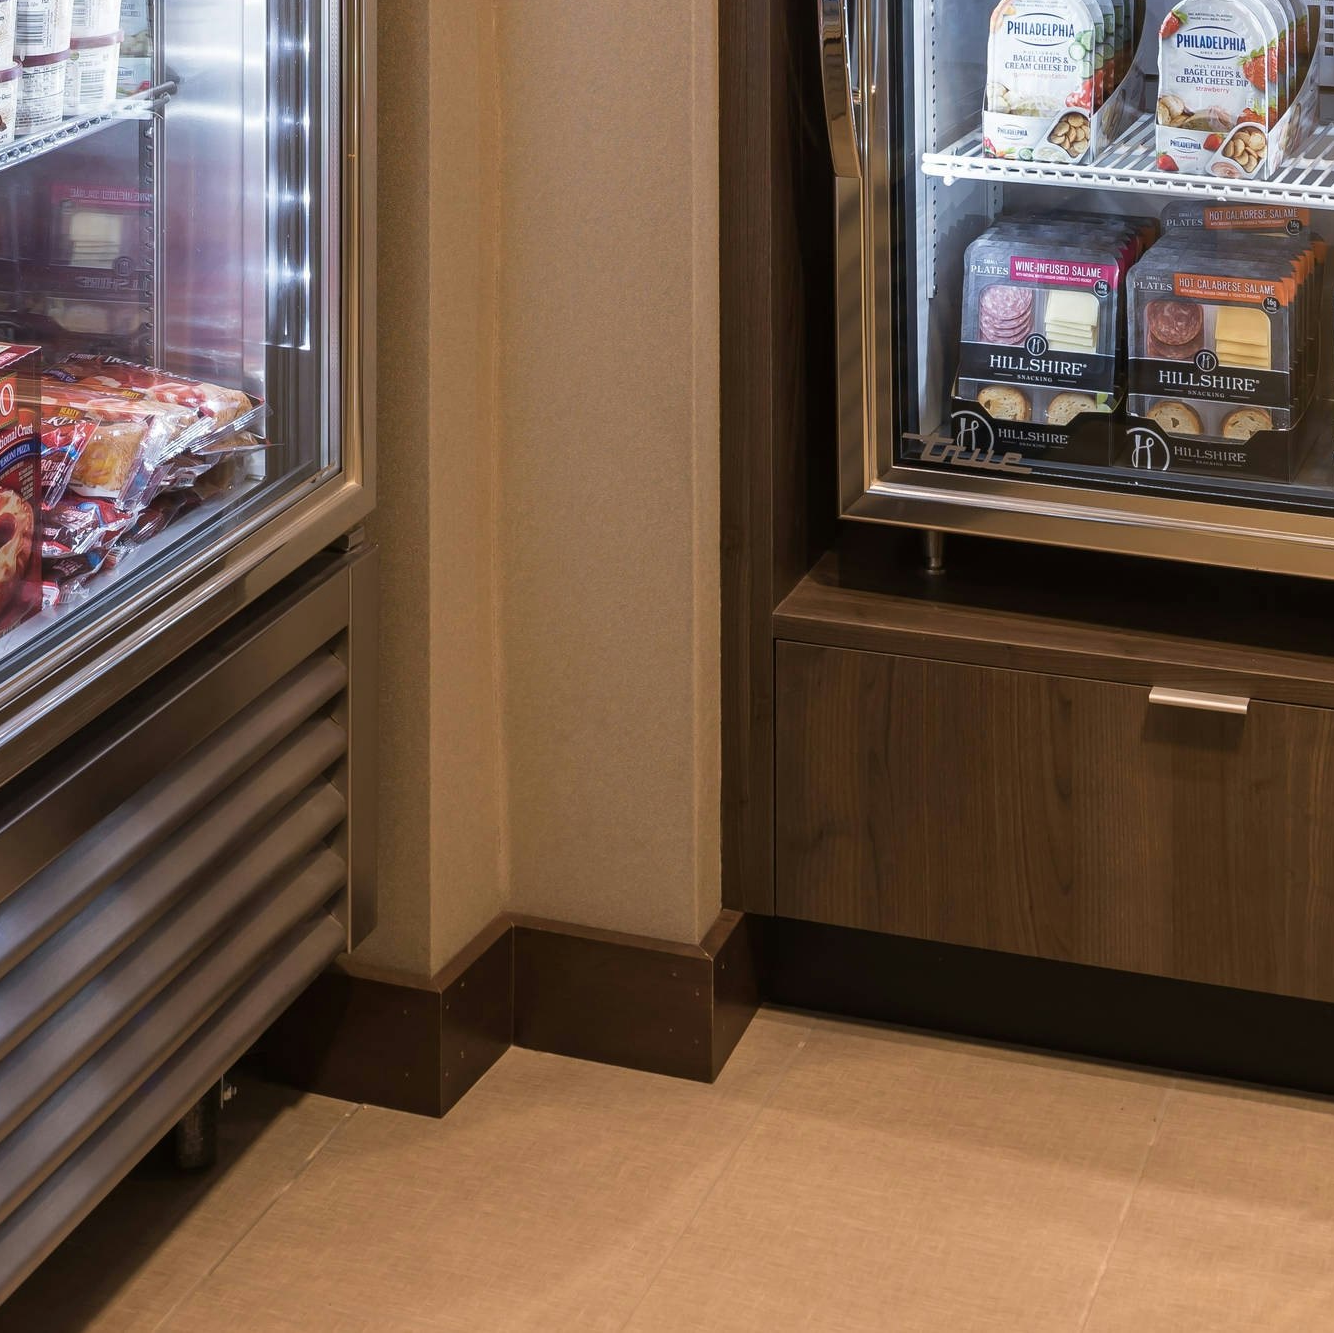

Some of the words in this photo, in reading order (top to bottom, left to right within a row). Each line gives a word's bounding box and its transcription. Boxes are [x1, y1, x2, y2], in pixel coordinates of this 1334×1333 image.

[1007, 20, 1076, 39] PHILADELPHIA
[1176, 33, 1247, 53] PHILADELPHIA
[1012, 54, 1035, 65] BAGEL
[1037, 55, 1061, 65] CHIPS
[1005, 62, 1031, 71] CREAM
[1033, 63, 1061, 72] CHEESE
[1062, 64, 1077, 74] DIP
[1183, 68, 1207, 77] BAGEL
[1209, 69, 1232, 78] CHIPS
[1175, 76, 1202, 85] CREAM
[1204, 77, 1233, 86] CHEESE
[1235, 78, 1249, 87] DIP
[1195, 86, 1229, 94] strawberry
[997, 126, 1028, 137] PHILADELPHIA
[1209, 210, 1224, 220] HOT
[1226, 209, 1267, 220] CALABRESE
[1269, 208, 1298, 218] SALAME
[1167, 217, 1203, 227] PLATES
[971, 265, 1009, 276] PLATES
[1015, 261, 1068, 276] WINE-INFUSED
[1072, 266, 1102, 278] SALAME
[1098, 281, 1108, 291] 16g
[1133, 282, 1173, 291] PLATES
[1179, 278, 1194, 289] HOT
[1197, 279, 1242, 292] CALABRESE
[1244, 284, 1275, 296] SALAME
[989, 354, 1082, 378] HILLSHIRE
[1017, 374, 1054, 383] SNACKING
[1159, 370, 1256, 393] HILLSHIRE
[1188, 390, 1224, 399] SNACKING
[17, 423, 34, 437] Crust
[998, 428, 1068, 445] HILLSHIRE
[1173, 446, 1247, 463] HILLSHIRE
